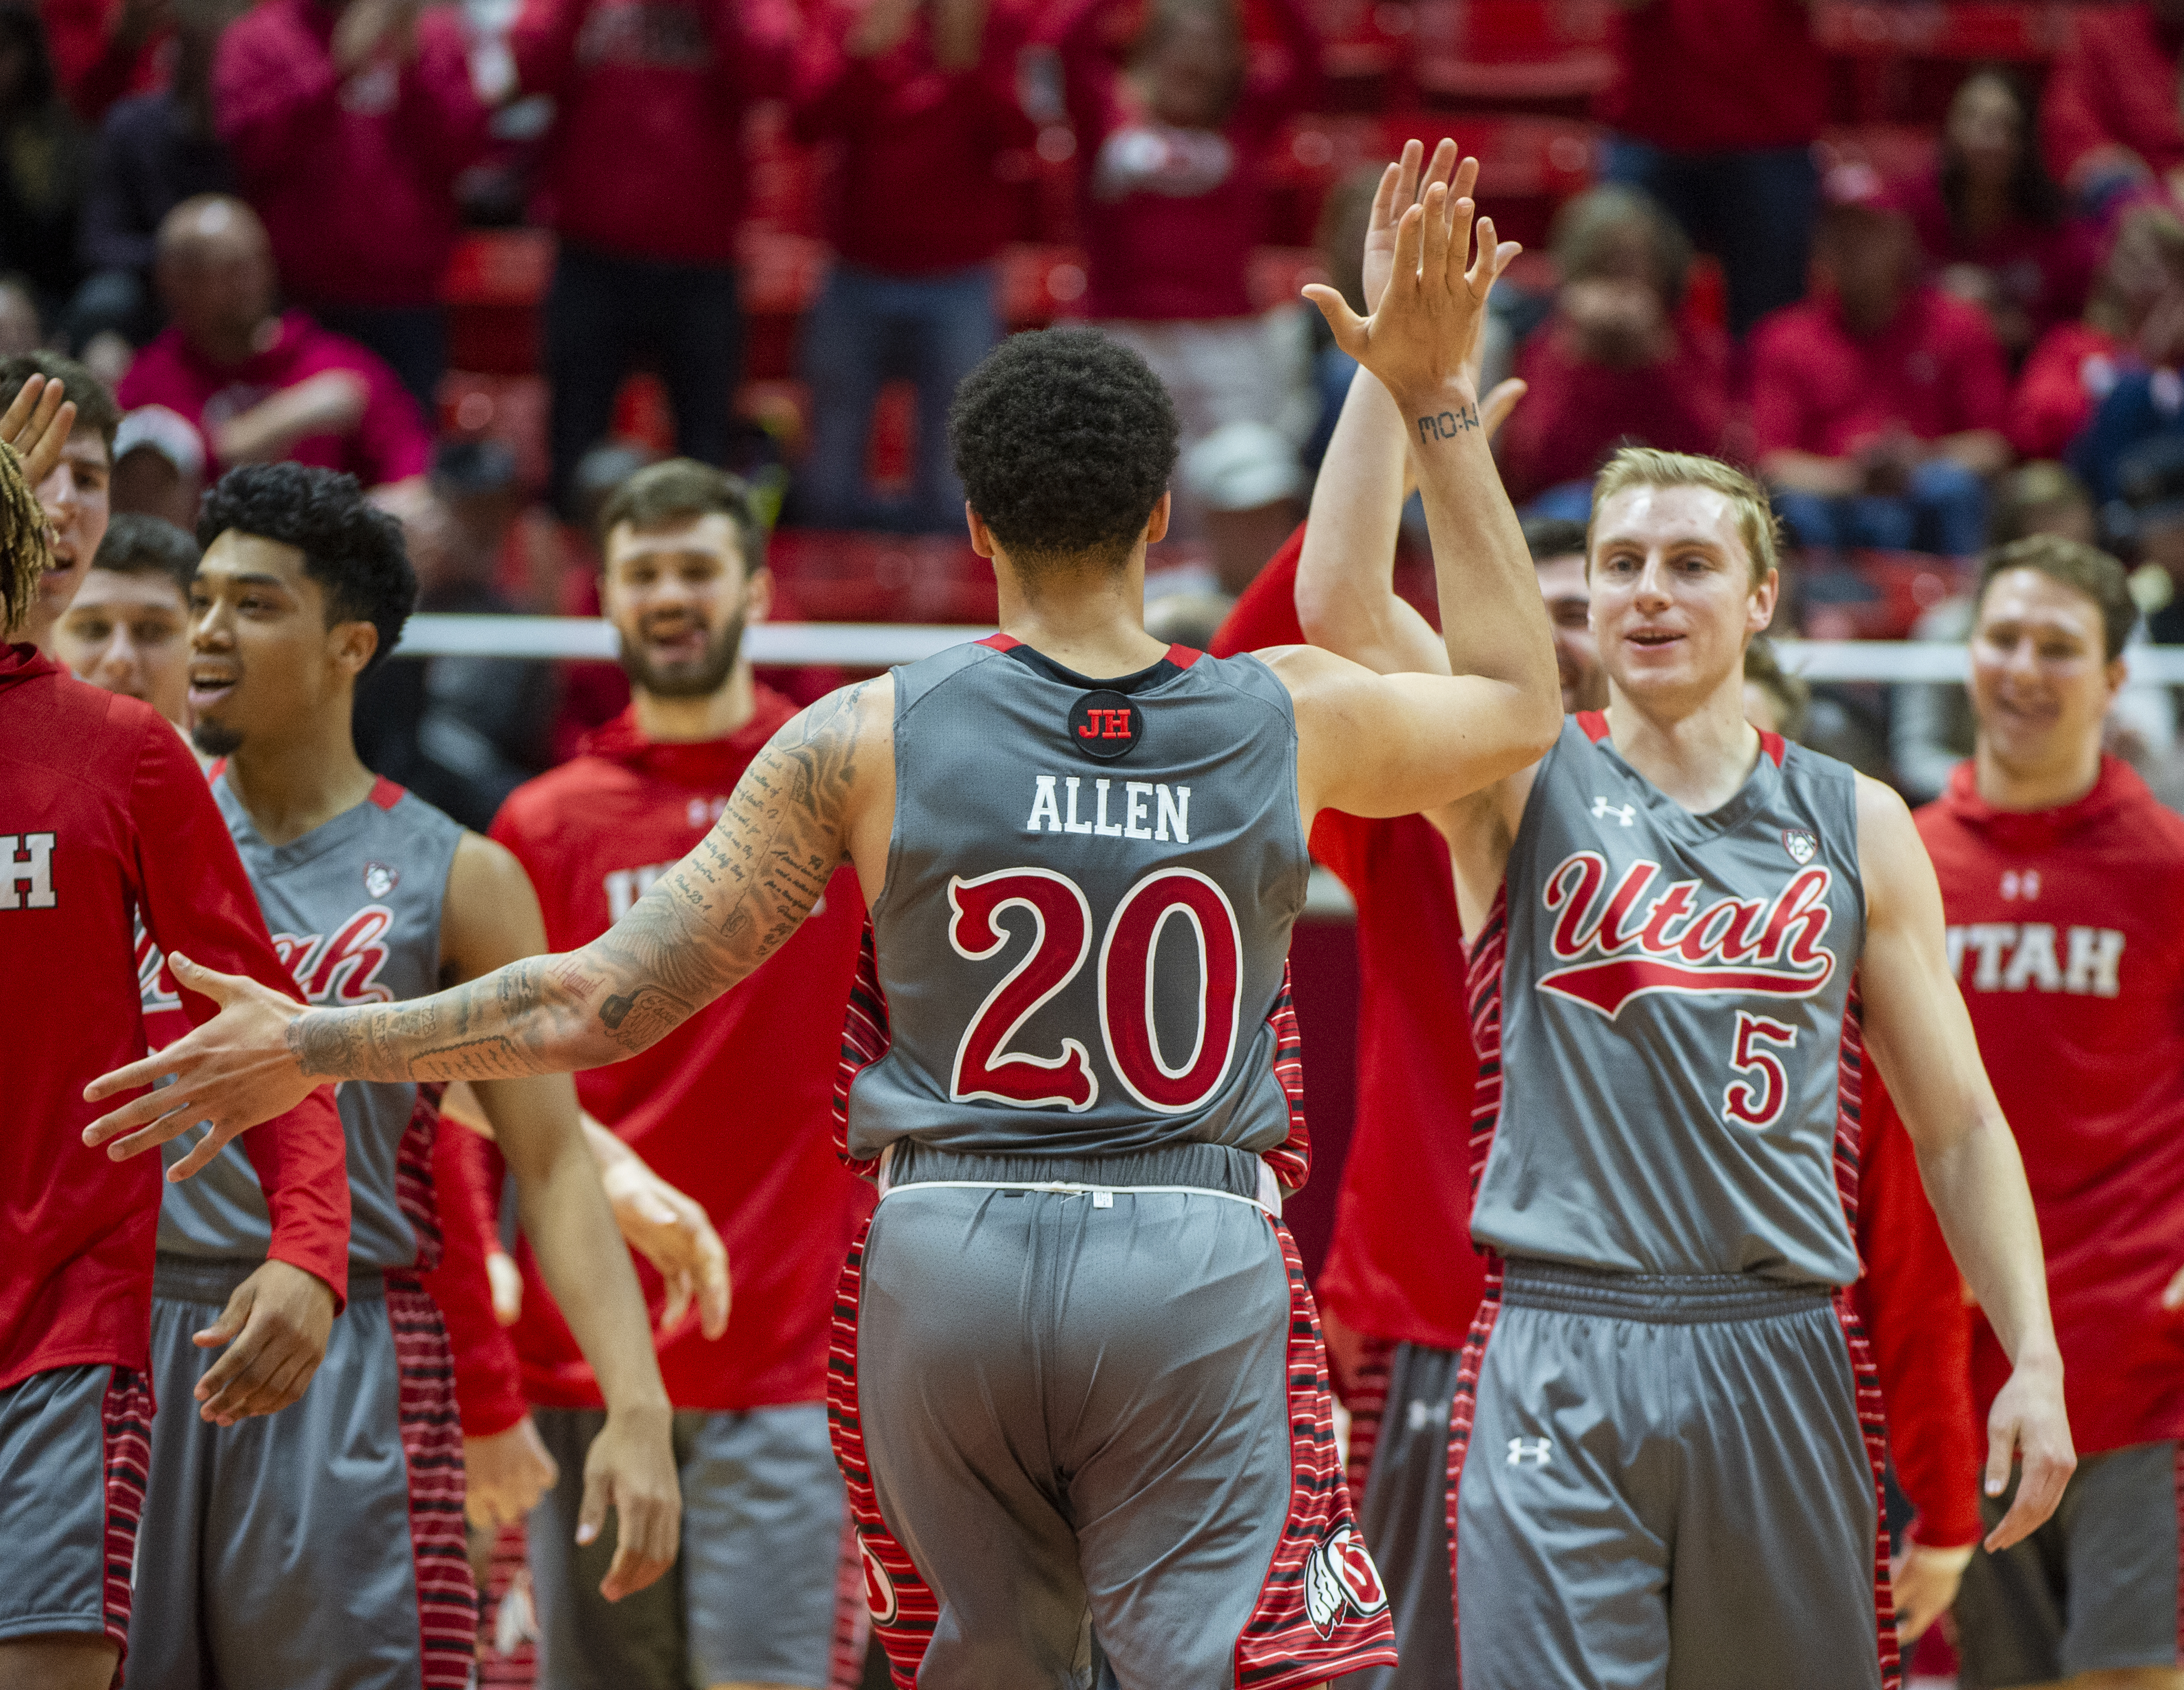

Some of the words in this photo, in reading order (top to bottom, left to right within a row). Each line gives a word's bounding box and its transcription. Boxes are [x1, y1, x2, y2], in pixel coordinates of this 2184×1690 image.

[1079, 709, 1131, 739] JH
[1027, 775, 1191, 844] ALLEN
[1543, 850, 1835, 971] Utah
[947, 867, 1243, 1114] 20
[1721, 1009, 1798, 1130] 5
